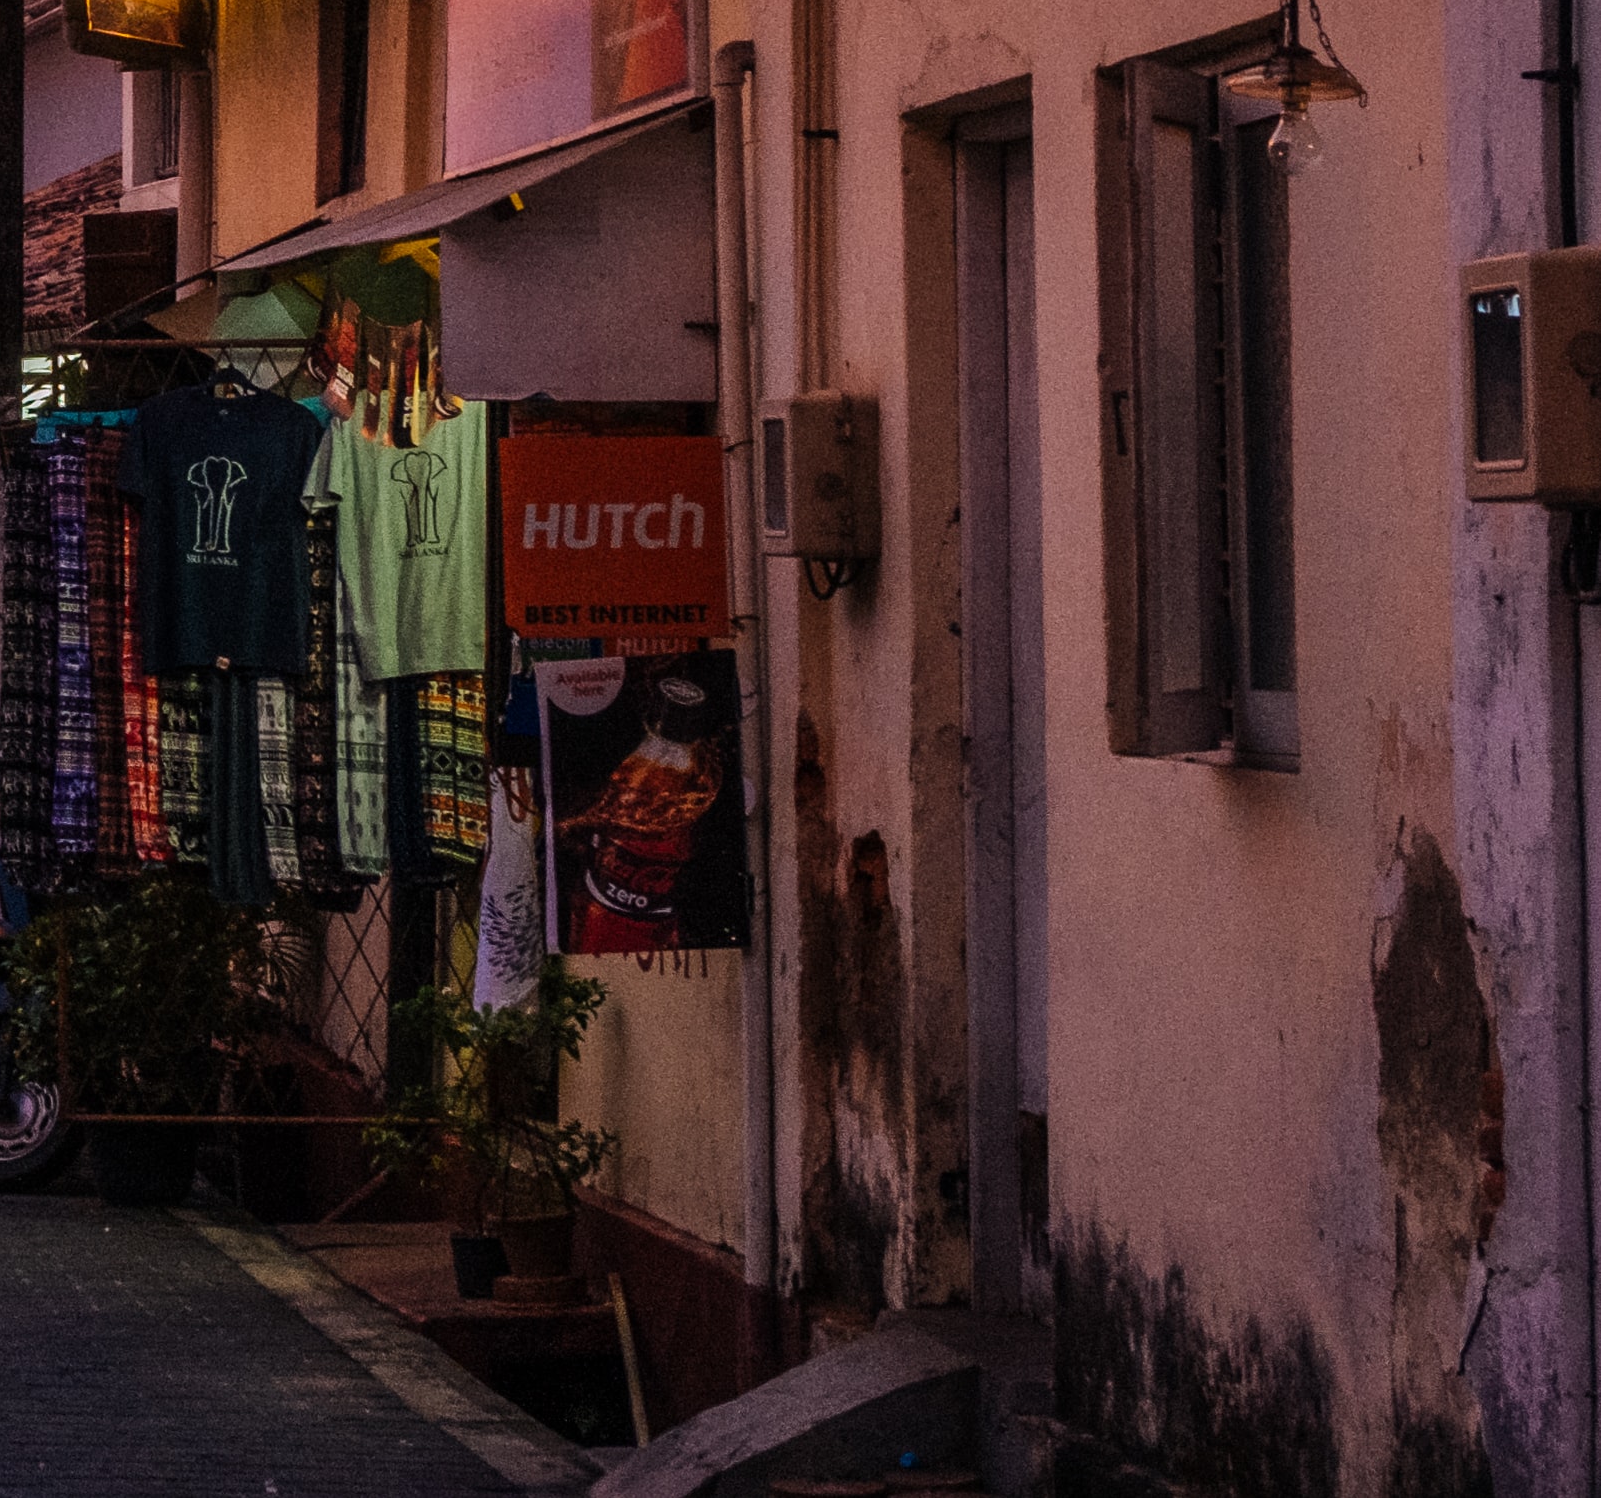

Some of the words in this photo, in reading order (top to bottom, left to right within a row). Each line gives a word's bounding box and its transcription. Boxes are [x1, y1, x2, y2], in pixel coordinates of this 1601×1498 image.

[526, 606, 582, 626] BEST
[590, 604, 709, 625] INTERNET
[556, 669, 621, 685] Available
[572, 685, 606, 697] here
[606, 882, 648, 908] zero
